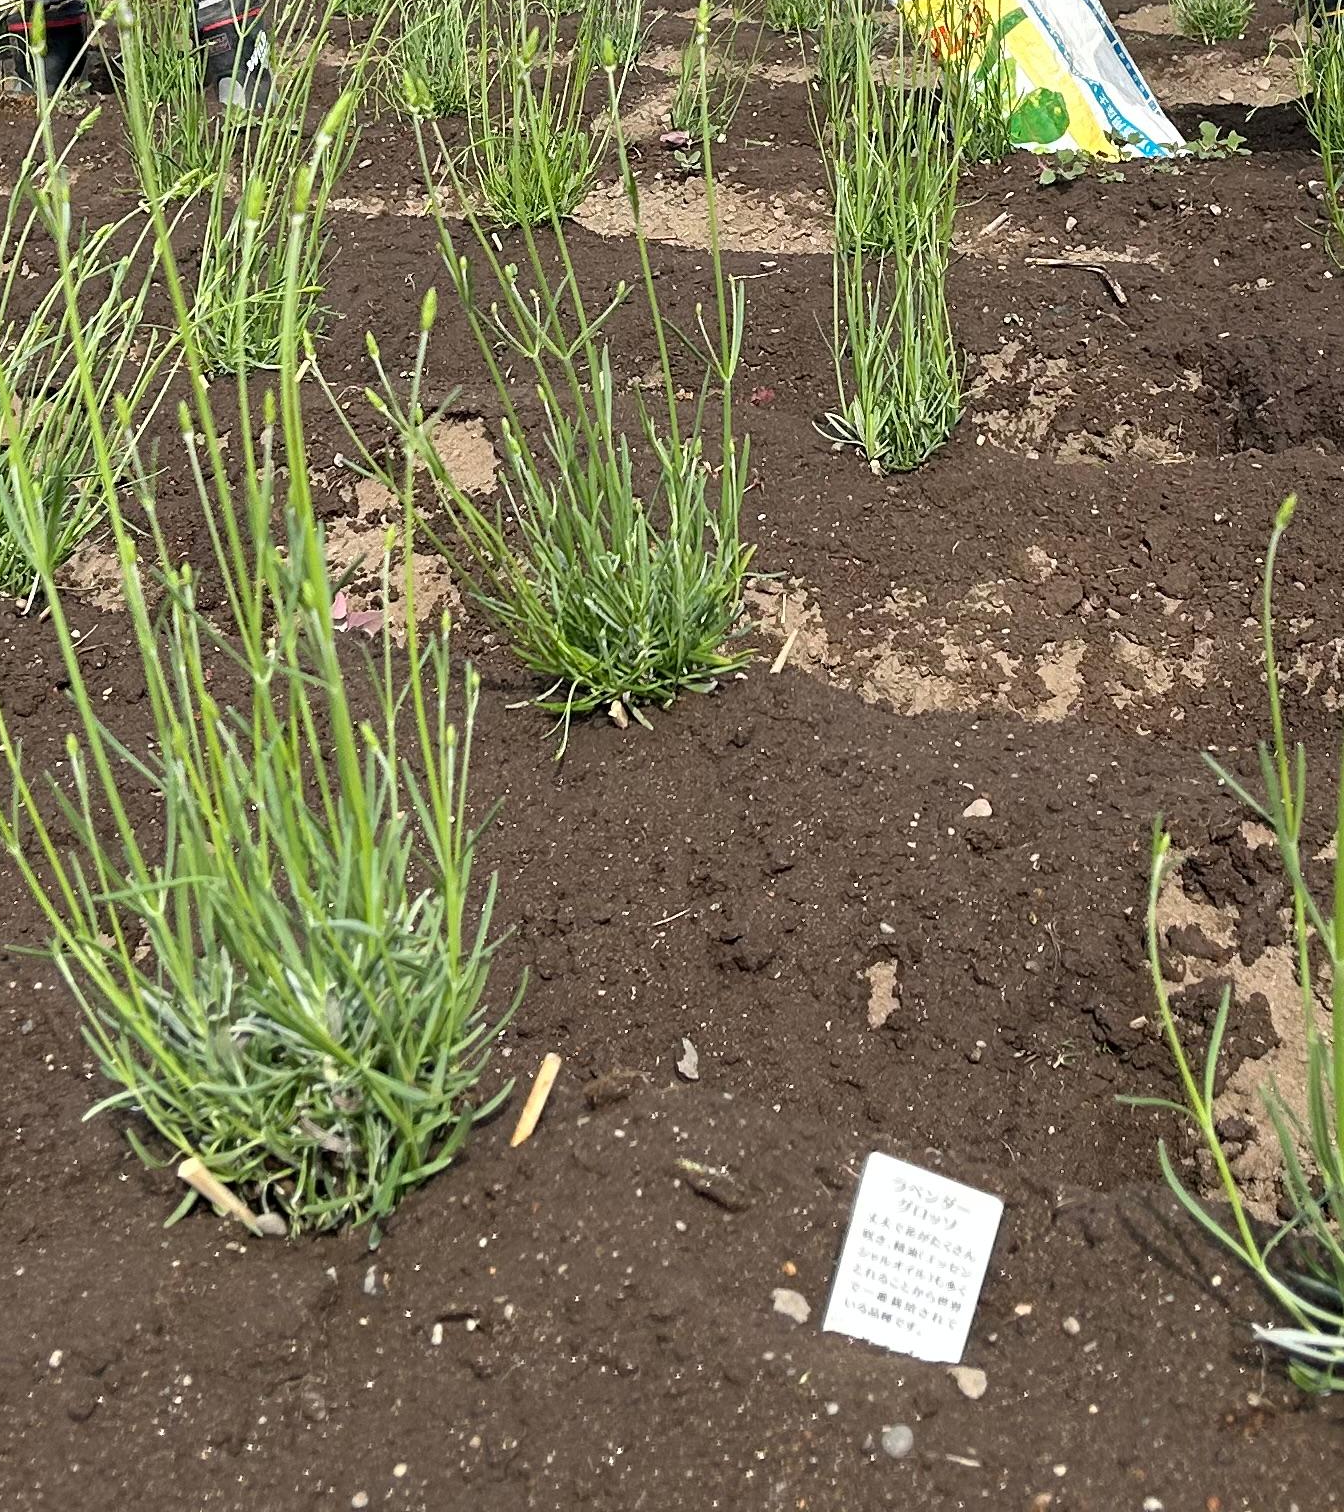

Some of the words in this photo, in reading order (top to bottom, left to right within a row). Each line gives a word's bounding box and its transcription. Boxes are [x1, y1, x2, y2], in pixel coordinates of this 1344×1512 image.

[894, 1176, 971, 1214] ラベンダー
